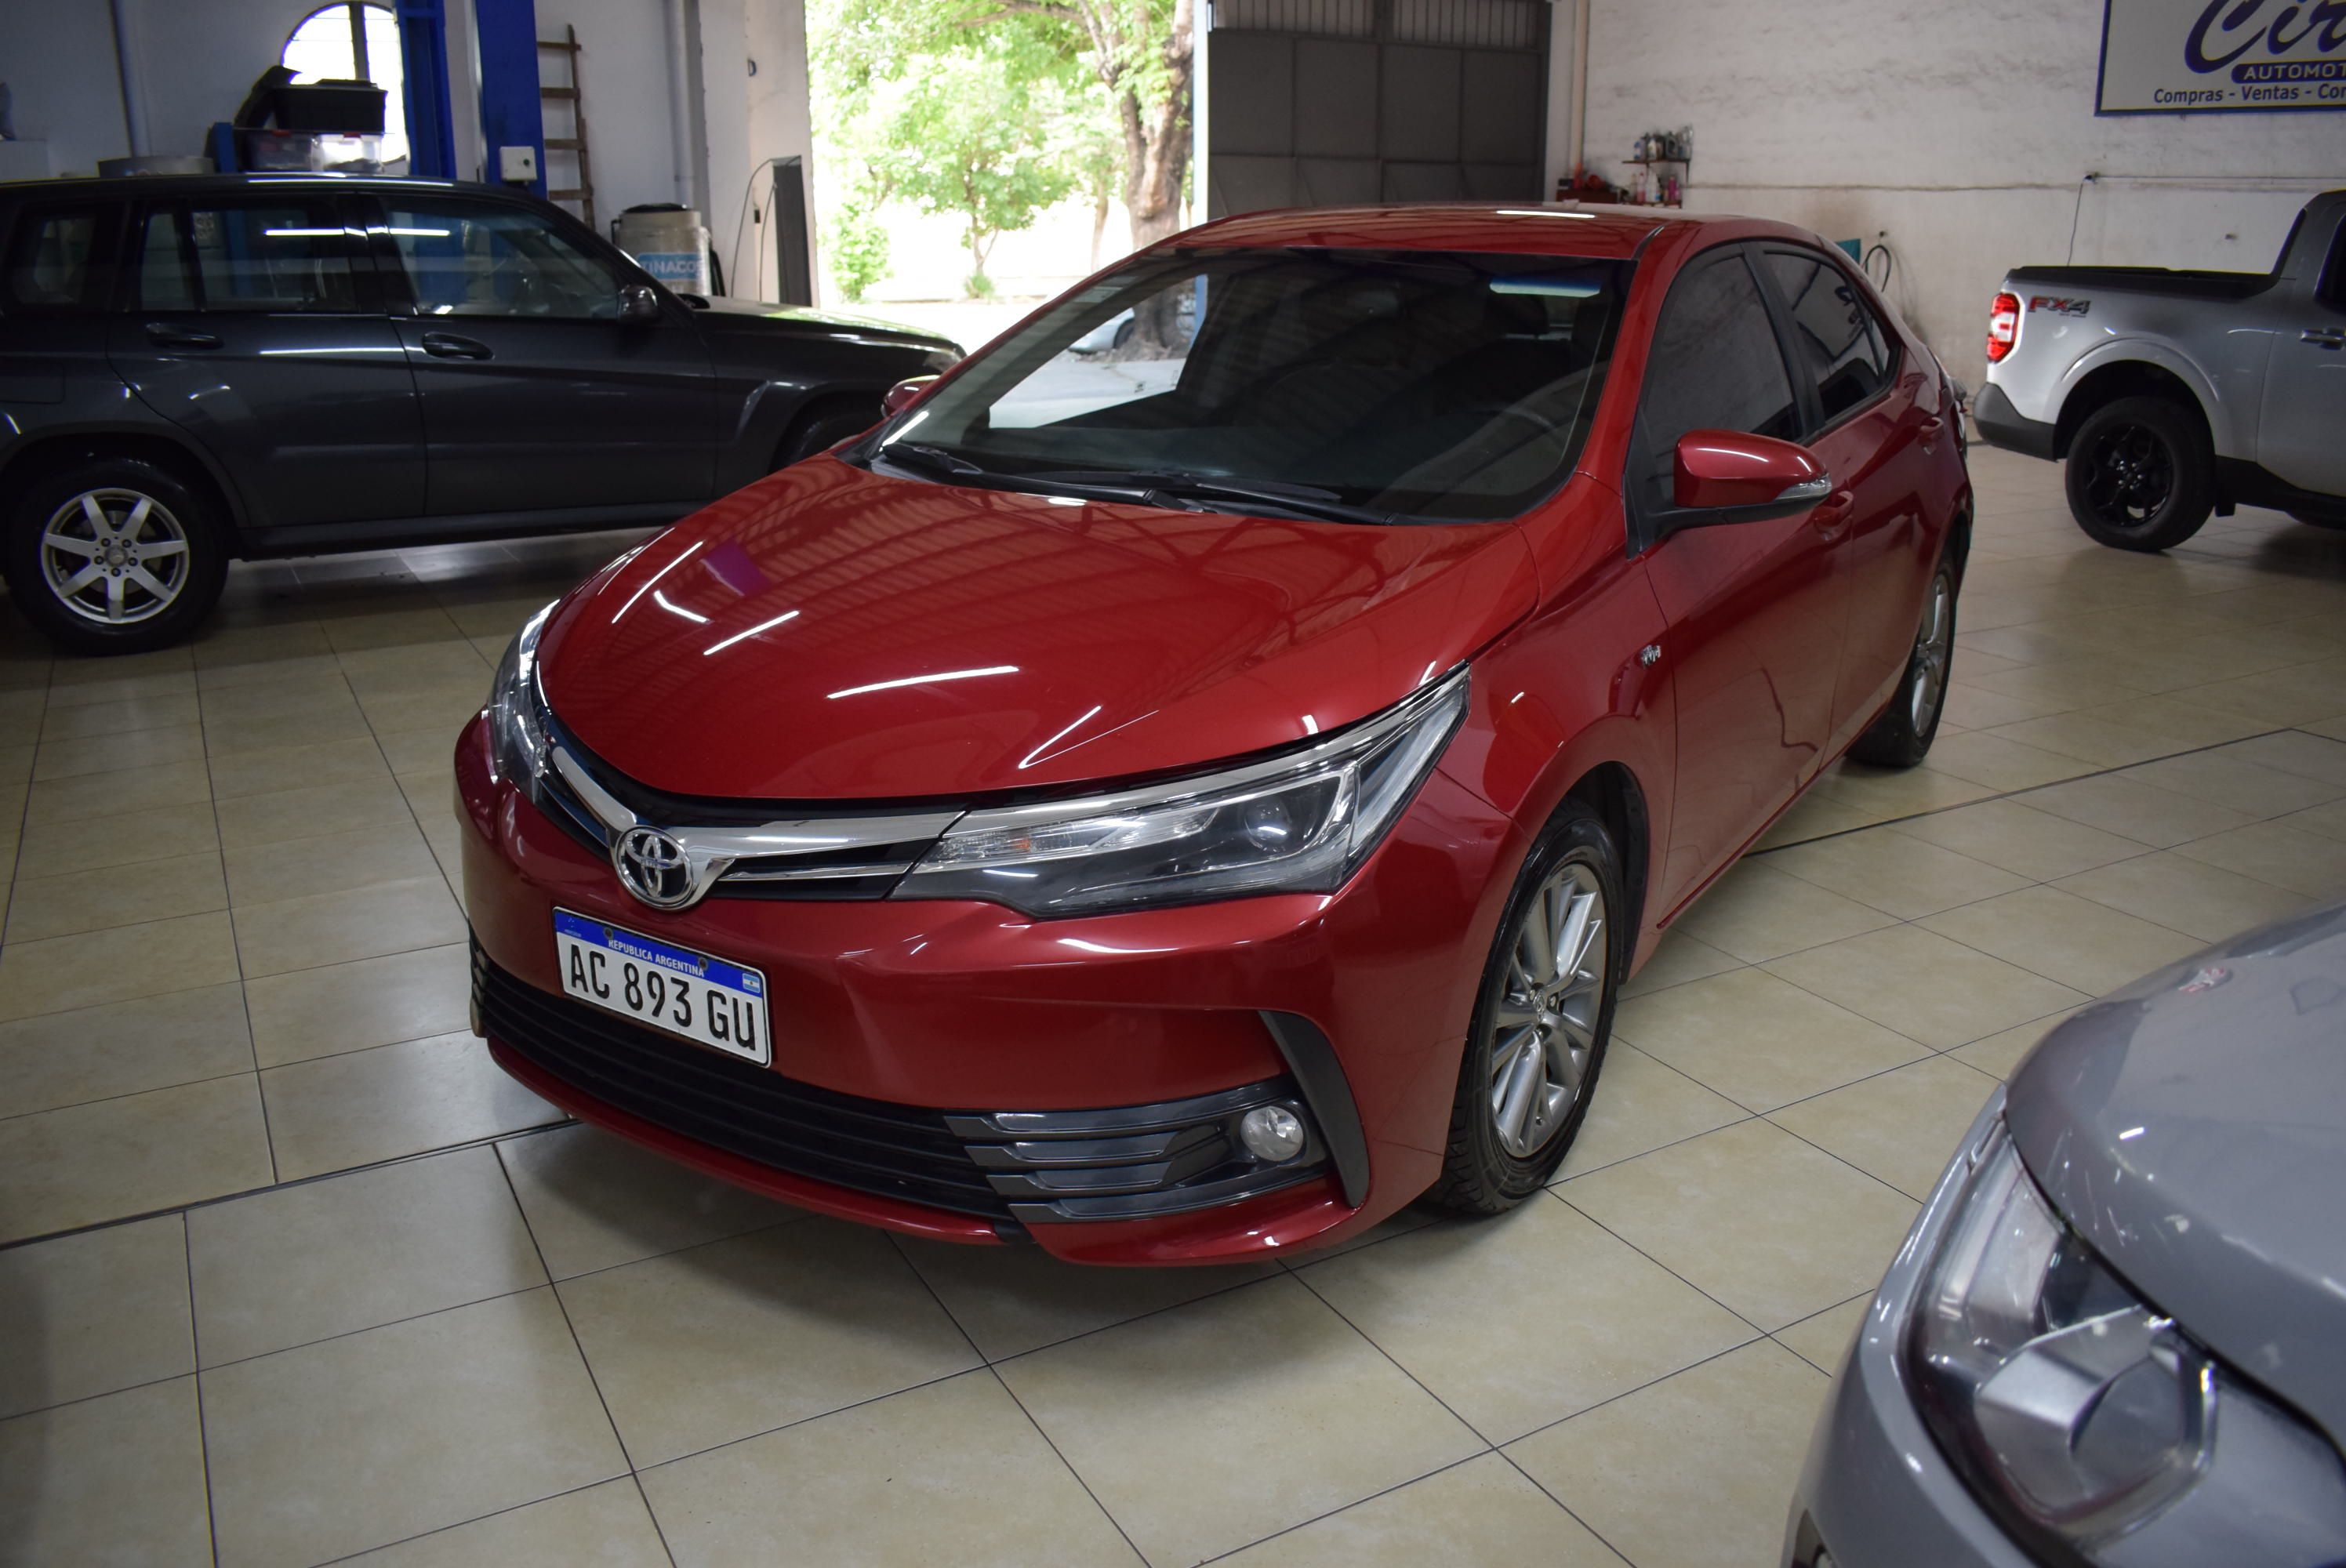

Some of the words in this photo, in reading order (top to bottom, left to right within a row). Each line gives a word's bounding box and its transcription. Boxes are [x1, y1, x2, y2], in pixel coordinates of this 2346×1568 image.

[2154, 88, 2224, 106] Compras
[2242, 85, 2299, 100] Ventas
[2028, 295, 2091, 314] FX4
[608, 938, 653, 963] REPUBLICA
[655, 953, 705, 978] ARGENTINA
[570, 943, 610, 1000] AC
[623, 962, 692, 1028] 893
[706, 989, 756, 1051] GU
